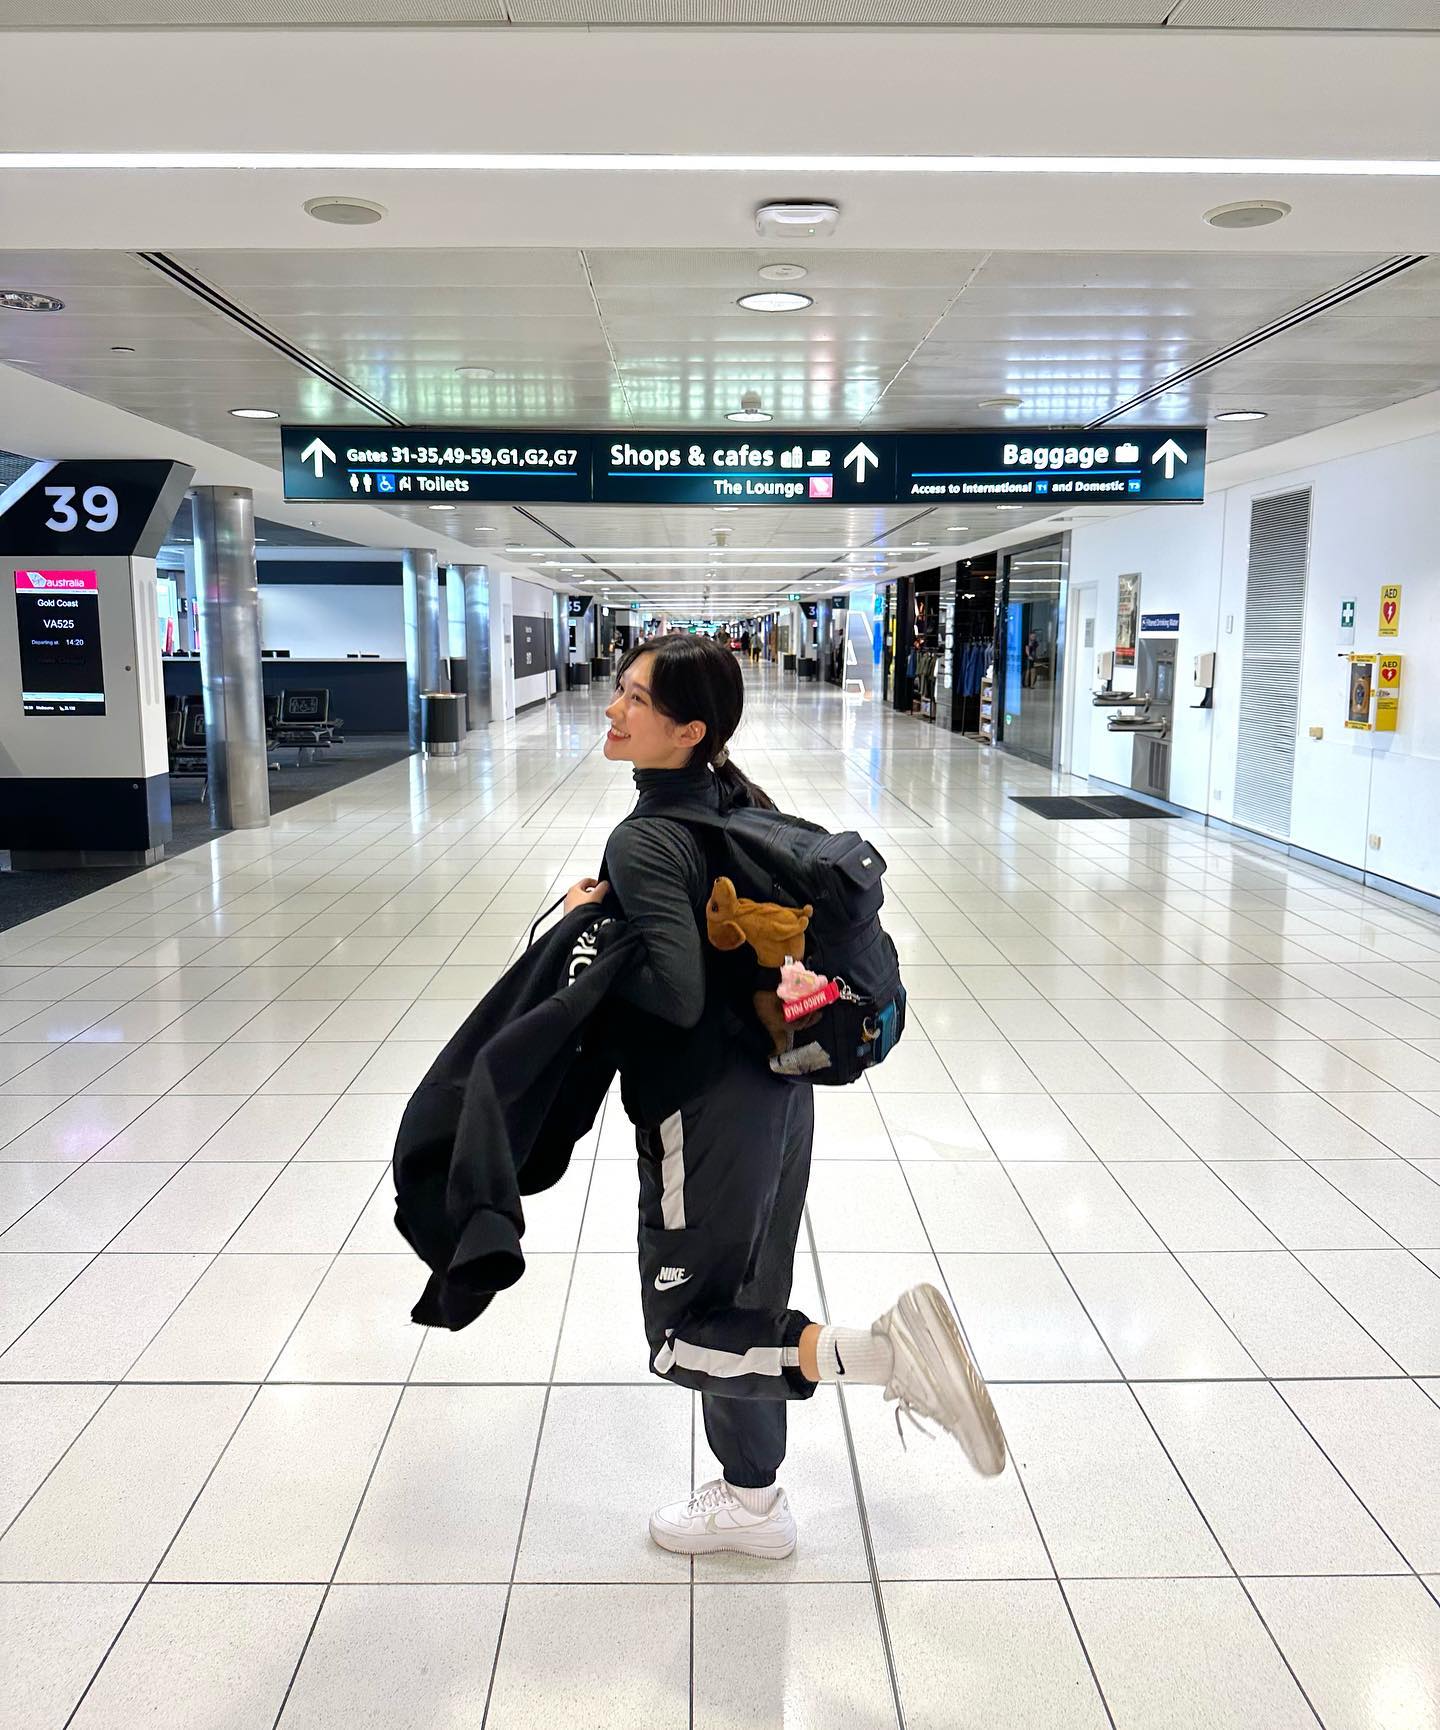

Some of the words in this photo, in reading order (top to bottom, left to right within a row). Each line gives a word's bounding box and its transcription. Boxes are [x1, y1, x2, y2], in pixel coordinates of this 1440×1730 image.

[346, 448, 388, 463] Gates
[391, 446, 577, 467] 31-35,49-59,G1,G2,G7
[610, 444, 681, 471] Shops
[687, 445, 706, 467] &
[712, 444, 774, 468] cafes
[1003, 443, 1109, 469] Baggage
[416, 475, 470, 492] Toilets
[714, 479, 742, 495] The
[745, 479, 804, 498] Lounge
[911, 483, 946, 494] Access
[948, 483, 961, 494] to
[962, 481, 1032, 494] International
[1051, 480, 1074, 492] and
[1074, 480, 1125, 492] Domestic
[45, 485, 119, 532] 39
[46, 578, 85, 587] australia
[1384, 588, 1398, 599] AED
[37, 598, 55, 607] Gold
[56, 598, 79, 607] Coast
[43, 619, 75, 629] VA525
[1382, 660, 1398, 668] AED
[803, 990, 827, 1010] MARCO
[784, 1001, 804, 1019] POLO
[659, 1266, 686, 1281] NIKE
